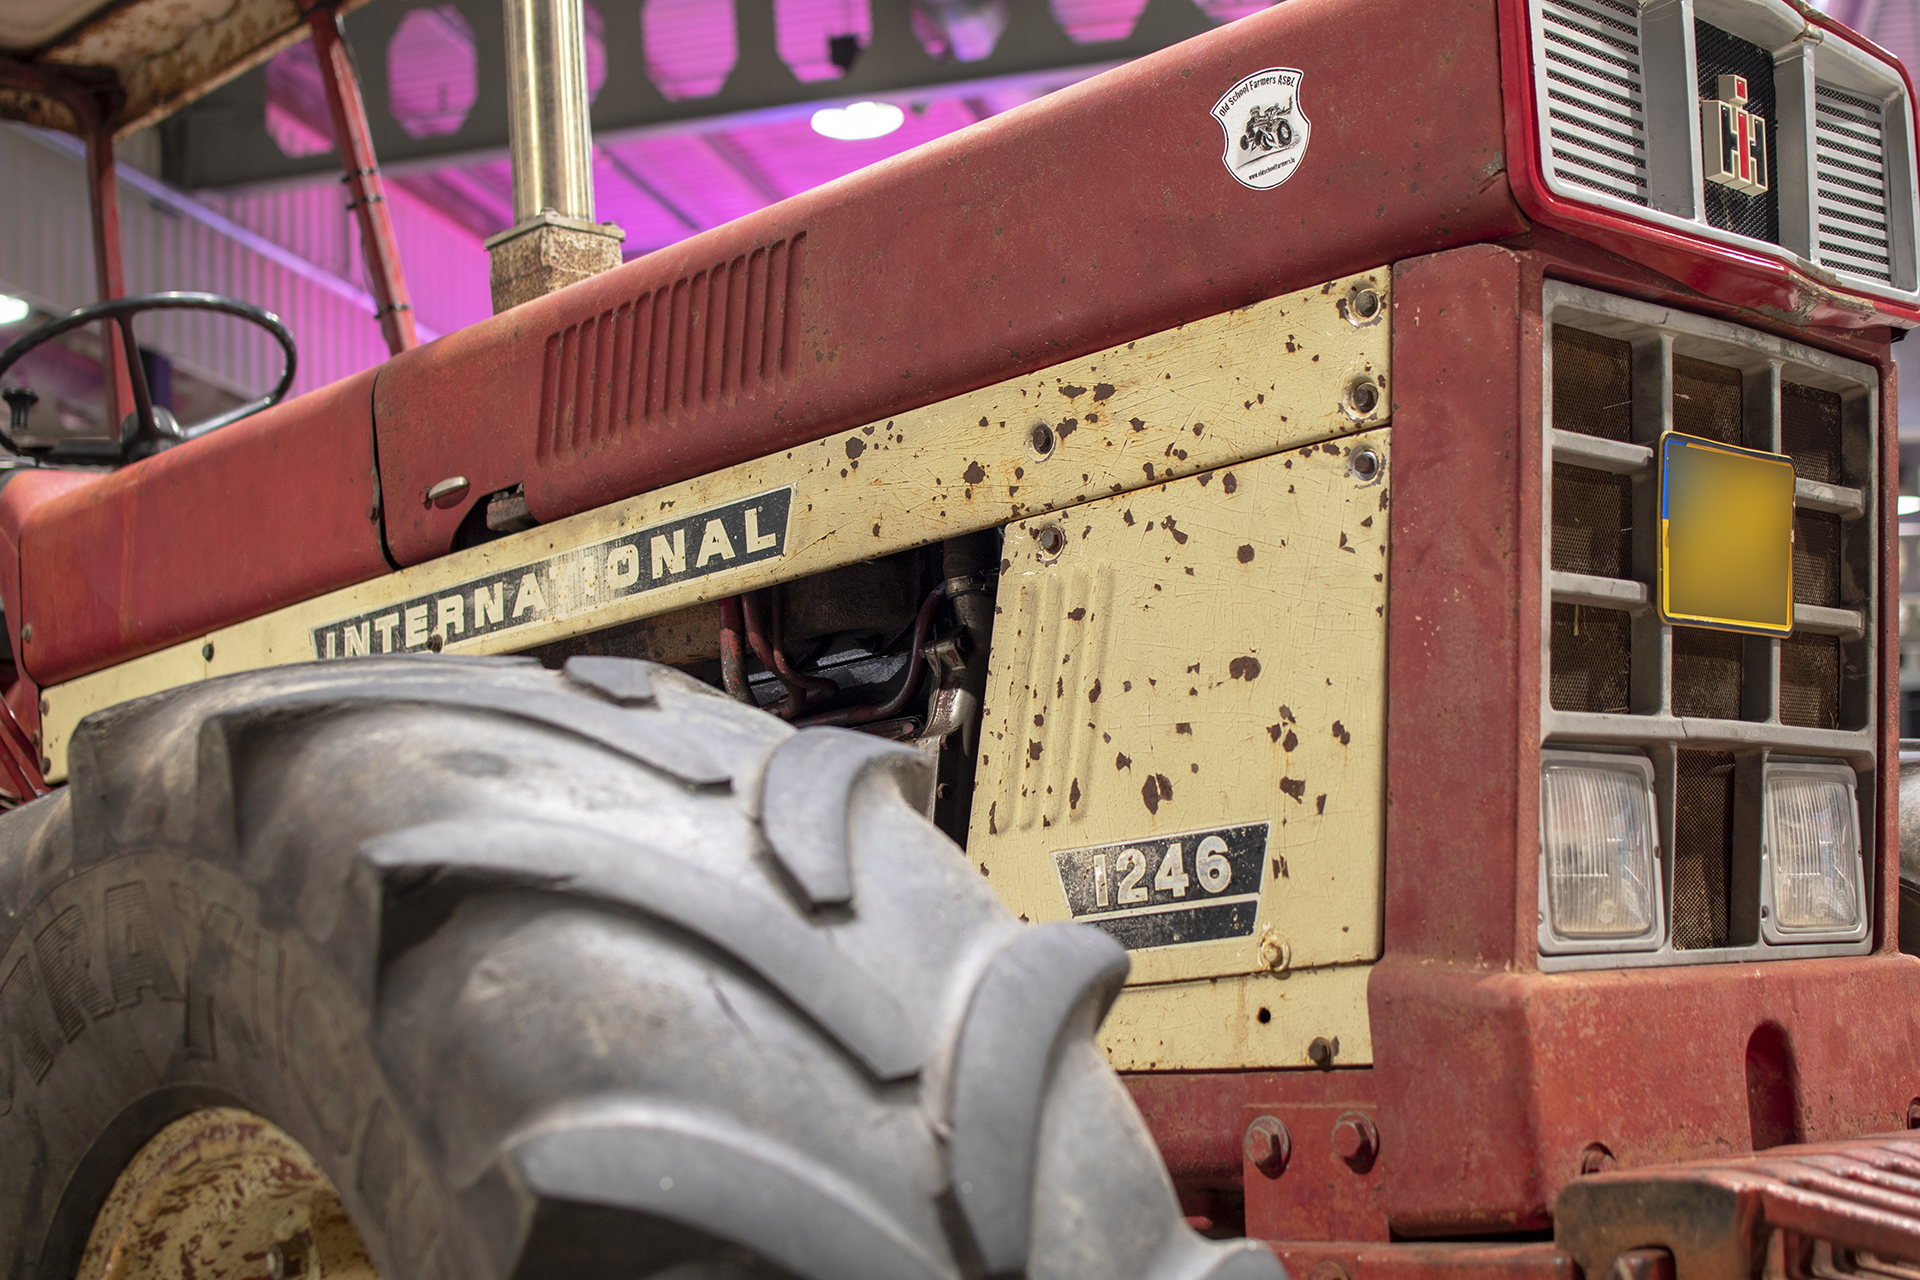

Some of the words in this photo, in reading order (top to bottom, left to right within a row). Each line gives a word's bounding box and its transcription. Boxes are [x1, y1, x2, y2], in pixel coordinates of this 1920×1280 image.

[1219, 102, 1230, 117] Old
[1228, 84, 1250, 105] School
[1249, 76, 1276, 90] Farmers
[1278, 75, 1295, 87] ASBL
[326, 506, 778, 660] INTERNATIONAL
[1093, 835, 1232, 907] 1246
